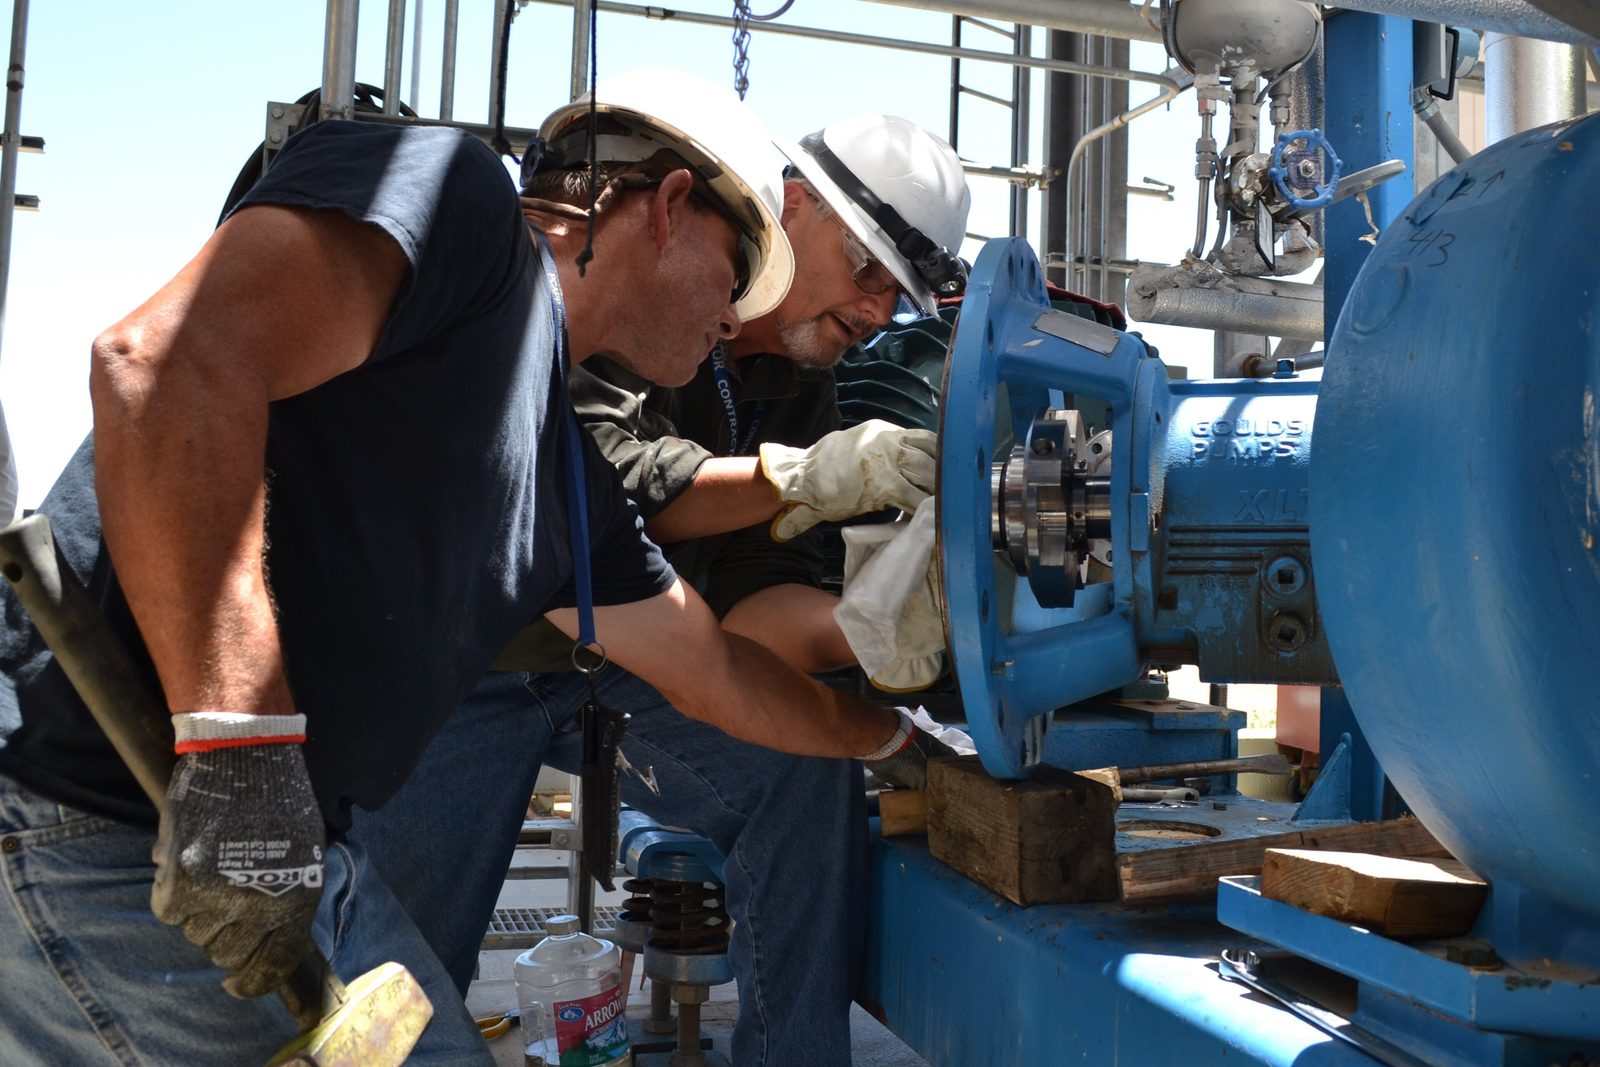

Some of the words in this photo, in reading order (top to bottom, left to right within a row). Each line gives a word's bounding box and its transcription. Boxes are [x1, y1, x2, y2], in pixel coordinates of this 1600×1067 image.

[712, 350, 725, 371] OR
[717, 379, 737, 455] CONTRACT
[1191, 420, 1303, 438] GOULDS
[1191, 437, 1299, 459] PUMPS
[225, 850, 249, 859] Level
[226, 841, 249, 850] Level
[266, 849, 287, 859] ANSI
